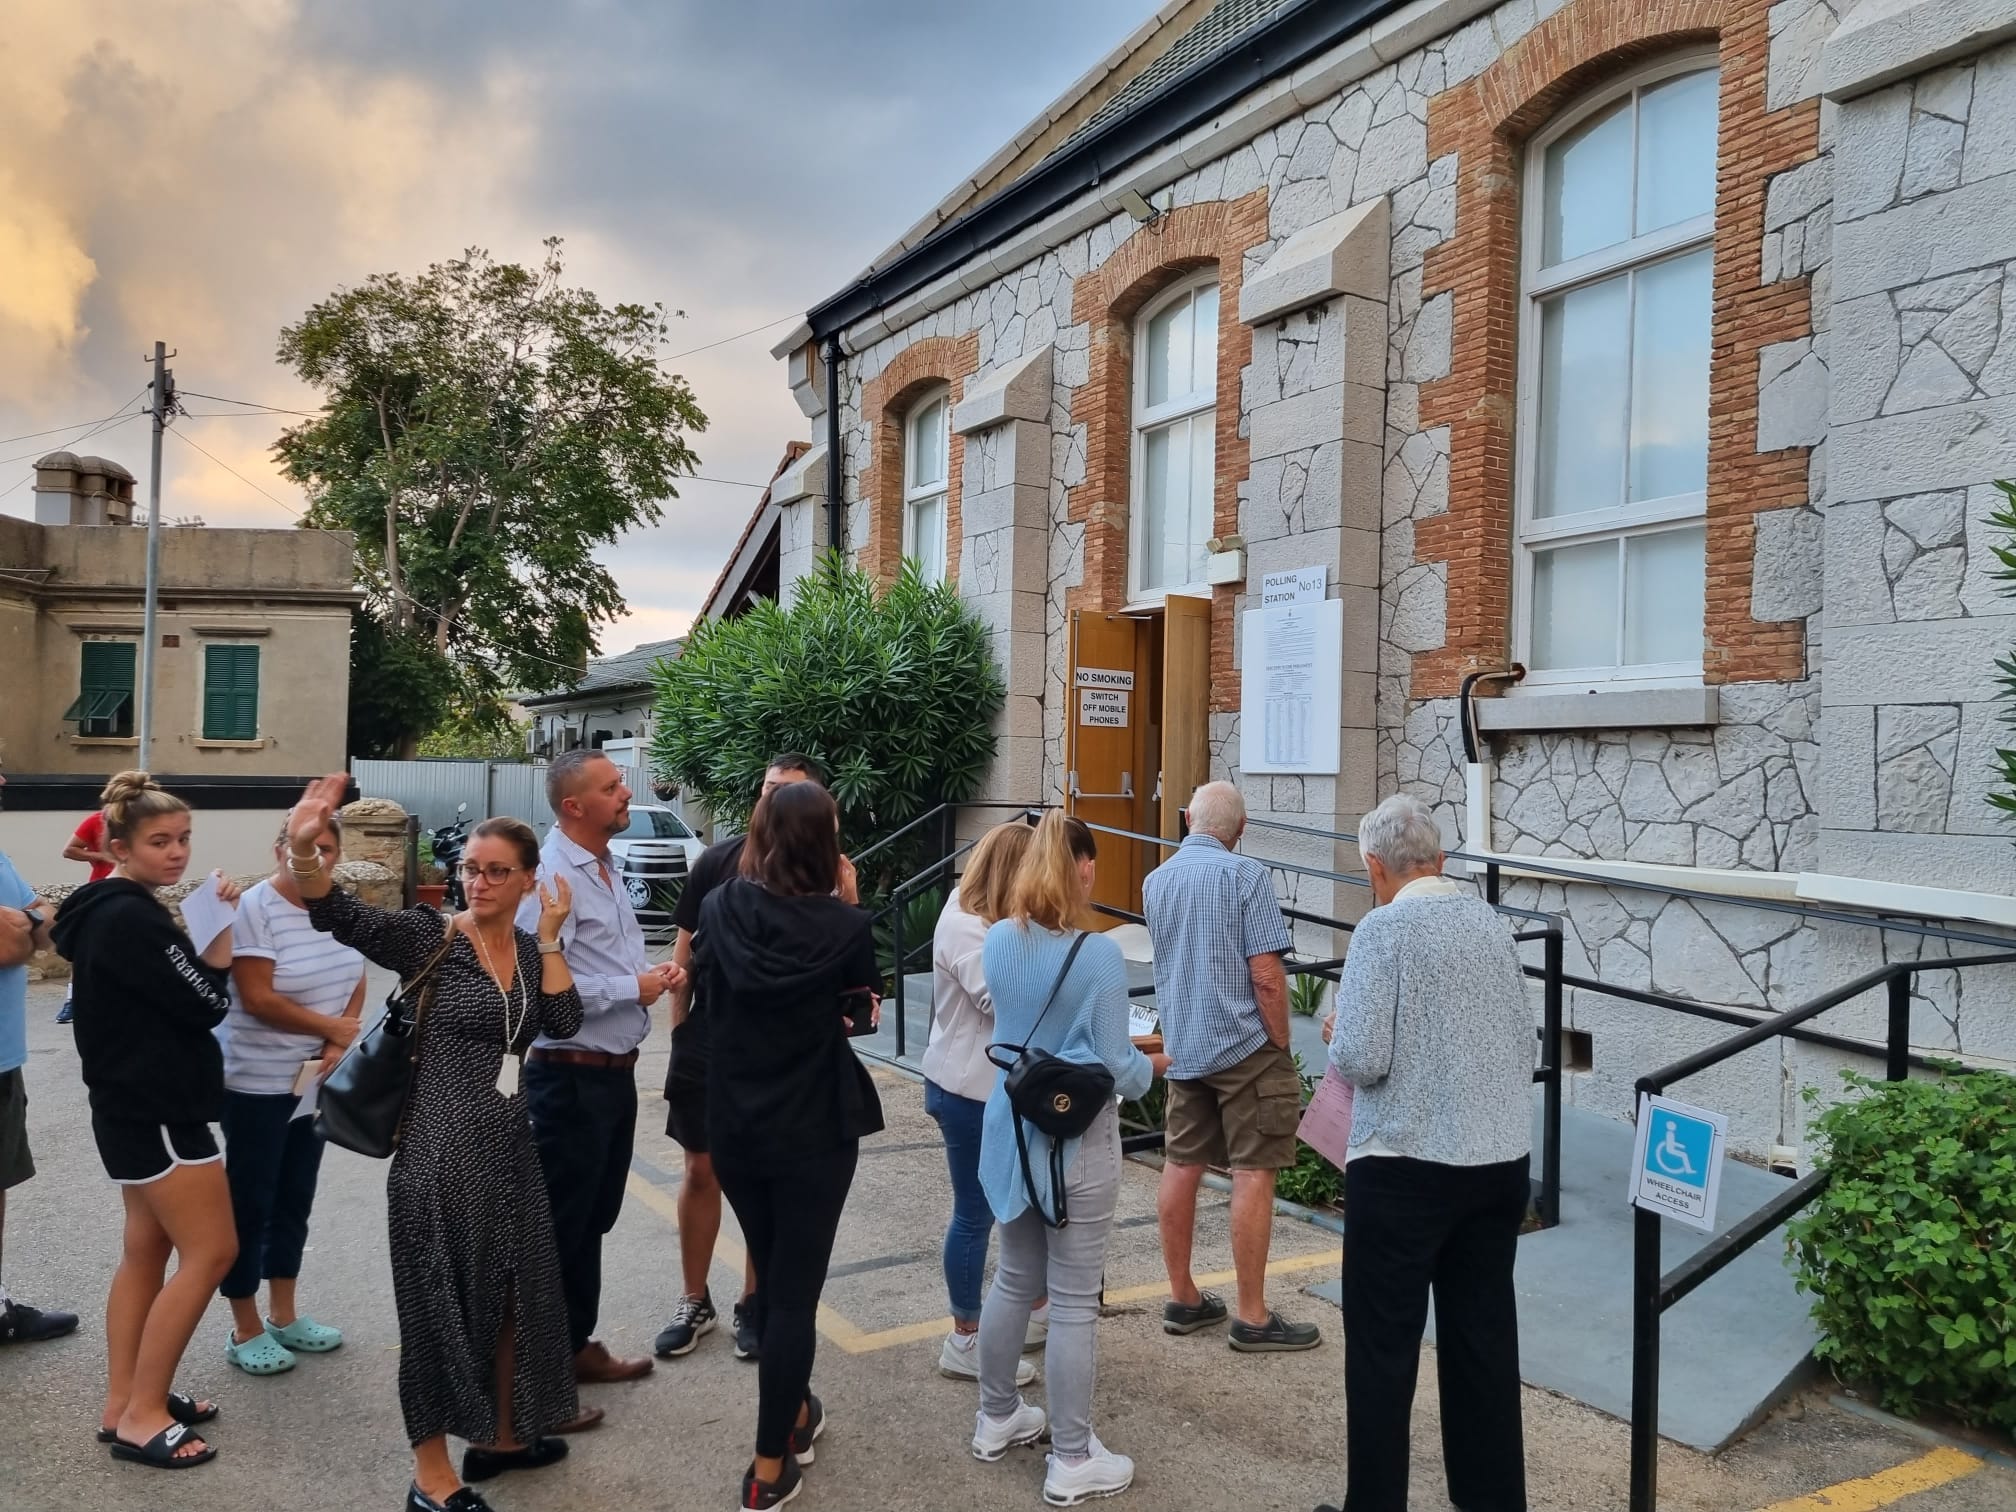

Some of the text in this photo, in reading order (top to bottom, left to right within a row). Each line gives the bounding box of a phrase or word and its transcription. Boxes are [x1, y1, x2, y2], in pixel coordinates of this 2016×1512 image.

[1265, 574, 1297, 588] POLLING
[1264, 591, 1296, 604] STATION
[1076, 672, 1132, 685] NO SMOKING
[1090, 692, 1119, 701] SWITCH
[1082, 703, 1127, 713] OFF MOBILE
[1089, 715, 1120, 725] PHONES
[1646, 1177, 1702, 1202] WHEELCHAIR
[1655, 1192, 1690, 1209] ACCESS
